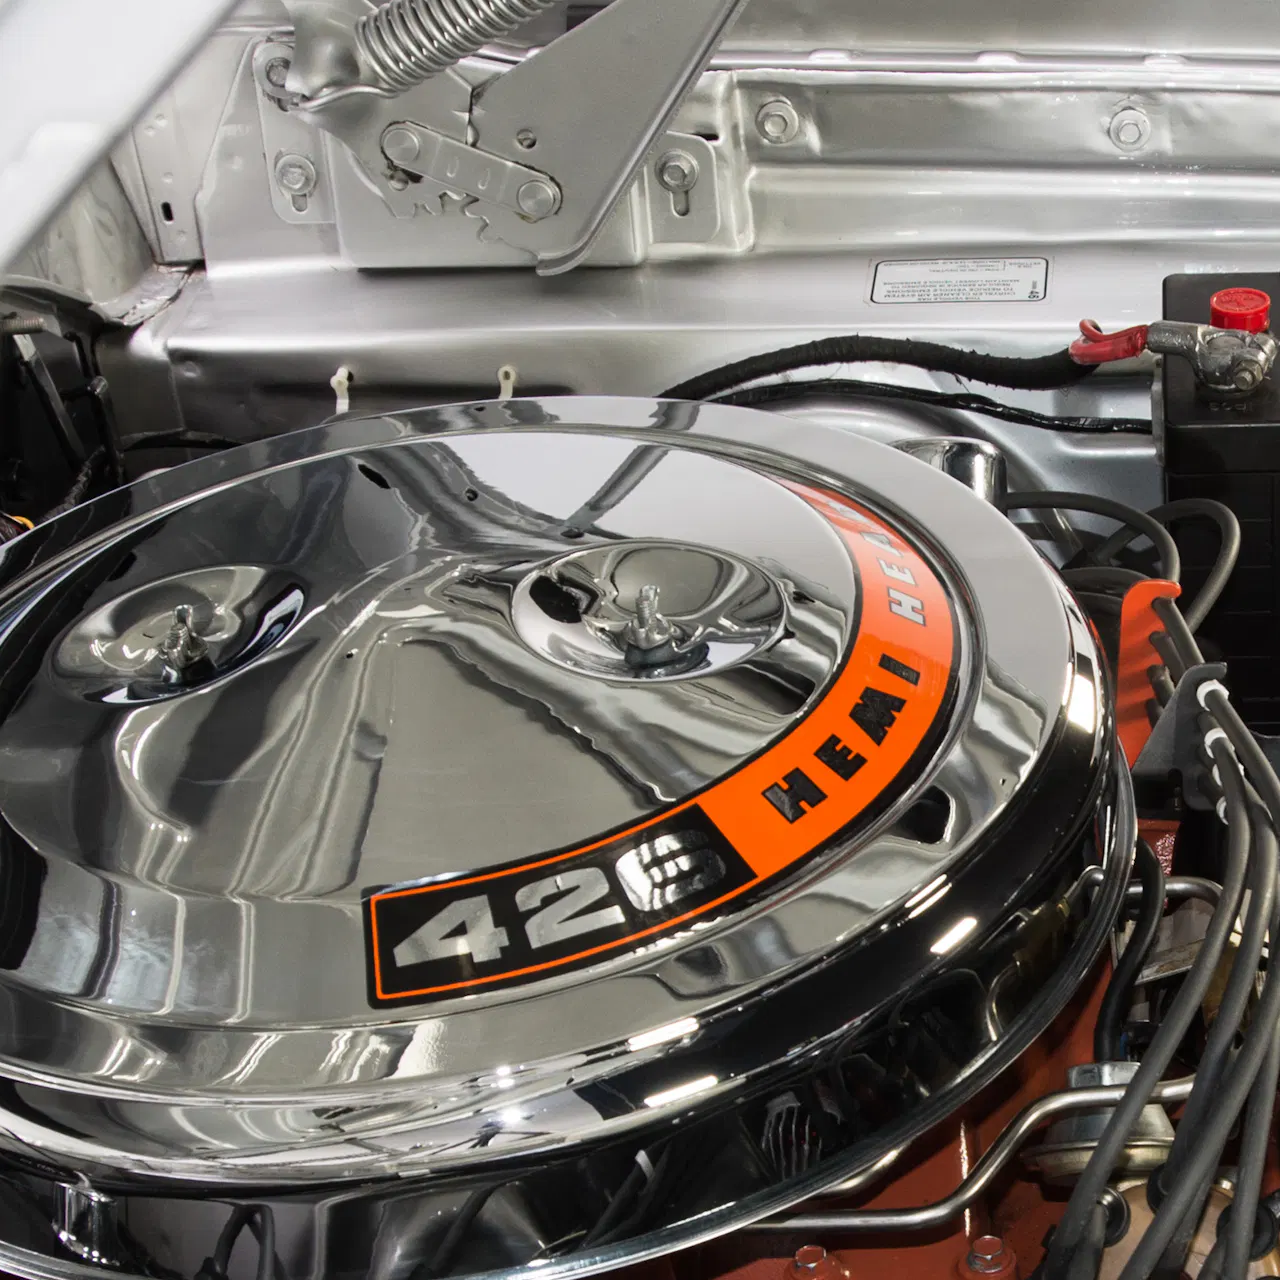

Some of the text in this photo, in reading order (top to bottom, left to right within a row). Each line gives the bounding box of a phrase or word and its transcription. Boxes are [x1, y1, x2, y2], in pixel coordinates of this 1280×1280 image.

[392, 501, 926, 968] 426 HEMI HEAD
